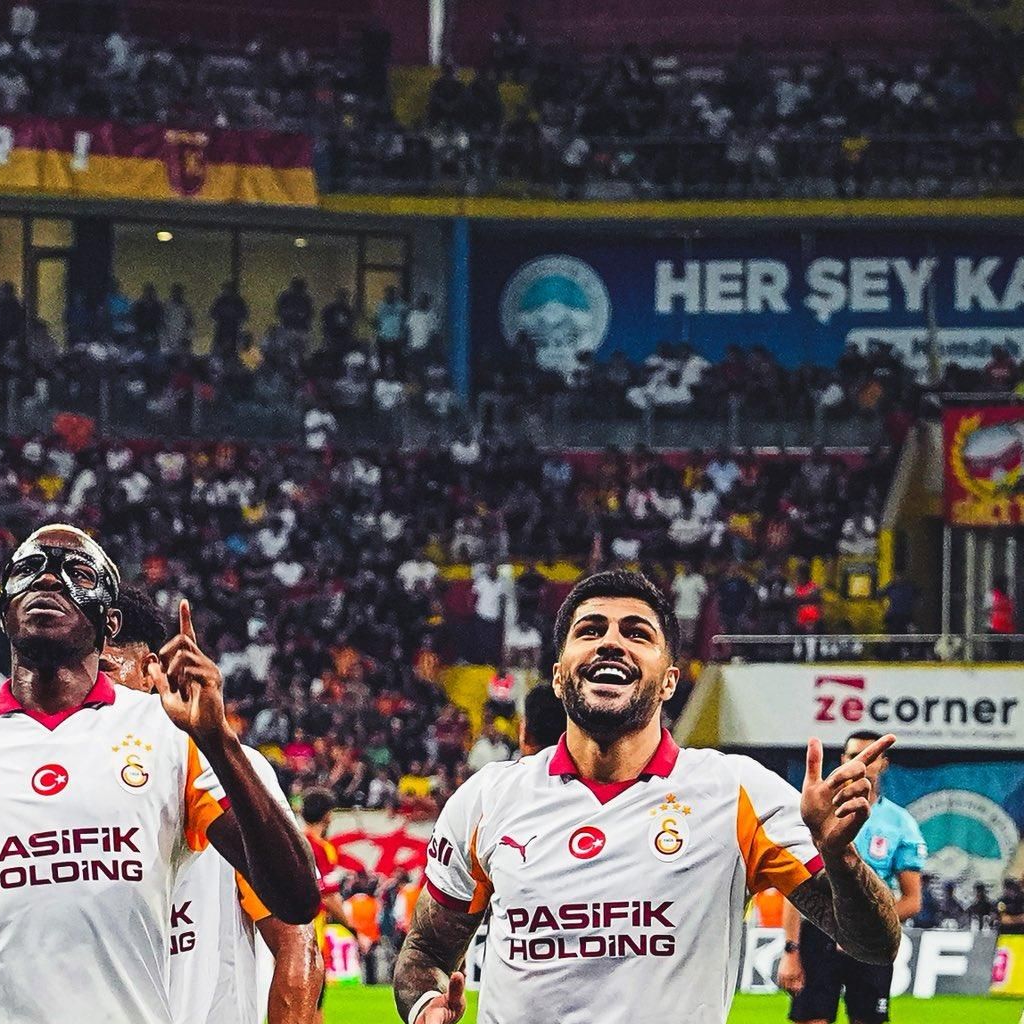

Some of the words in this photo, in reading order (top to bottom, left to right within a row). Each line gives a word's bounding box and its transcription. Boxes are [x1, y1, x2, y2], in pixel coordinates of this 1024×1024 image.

[655, 258, 792, 315] HER
[803, 256, 939, 325] ŞEY
[814, 694, 1019, 725] zecorner
